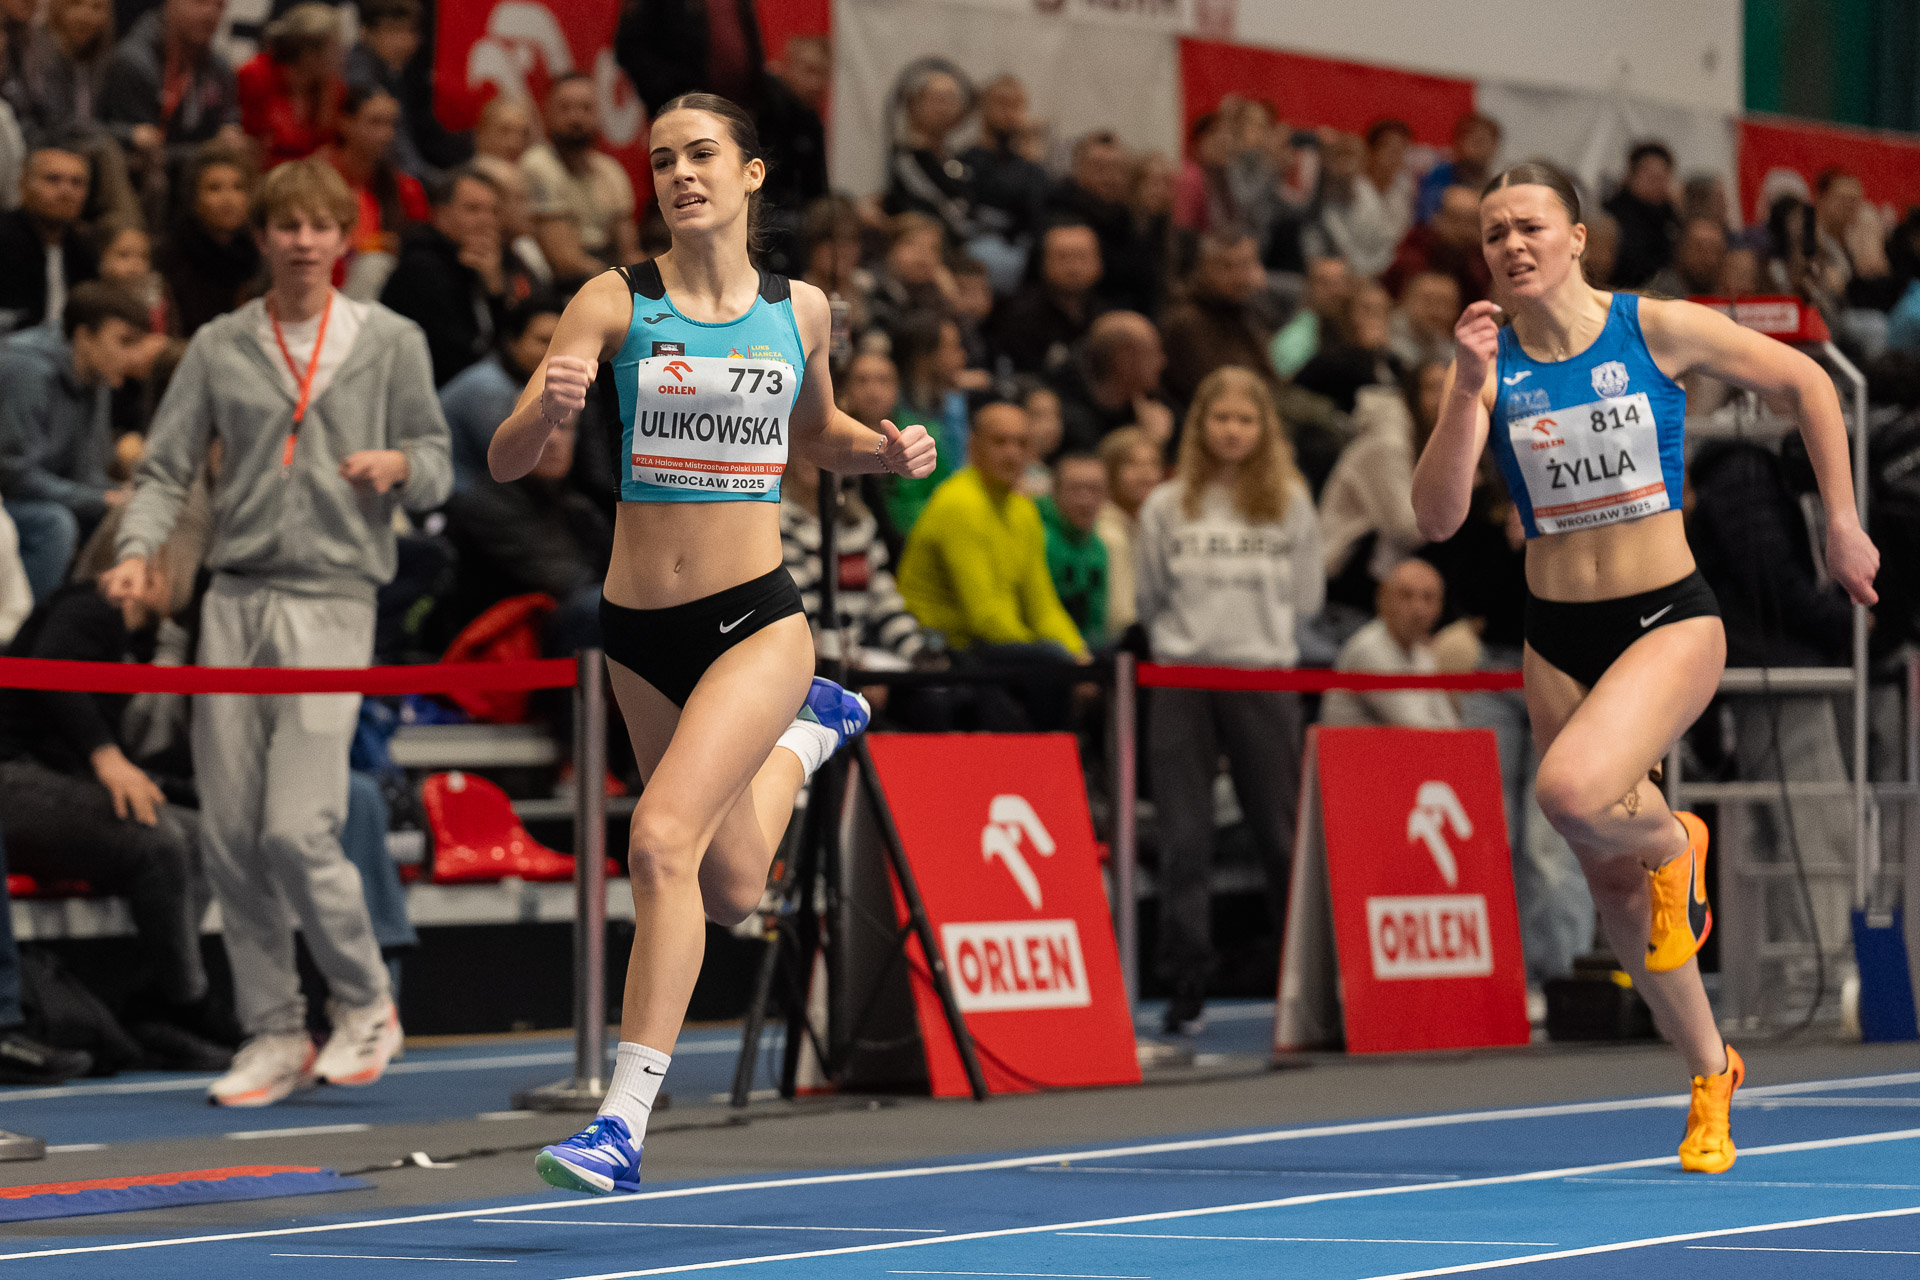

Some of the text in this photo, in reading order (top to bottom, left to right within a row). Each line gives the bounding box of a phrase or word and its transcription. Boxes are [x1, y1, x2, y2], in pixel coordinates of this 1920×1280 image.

[658, 385, 697, 396] ORLEN
[728, 367, 783, 395] 773
[641, 411, 783, 446] ULIKOWSKA
[1590, 404, 1641, 433] 814
[1531, 438, 1566, 451] ORLEN
[635, 457, 653, 465] PZLA
[654, 459, 683, 468] Halowe
[684, 462, 729, 472] Mistrzostwa
[1546, 449, 1637, 490] ŻYLLA
[654, 472, 765, 489] WROCŁAW 2025
[1555, 501, 1652, 529] WROCŁAW 2025
[1379, 908, 1482, 962] ORLEN
[955, 934, 1077, 995] ORLEN
